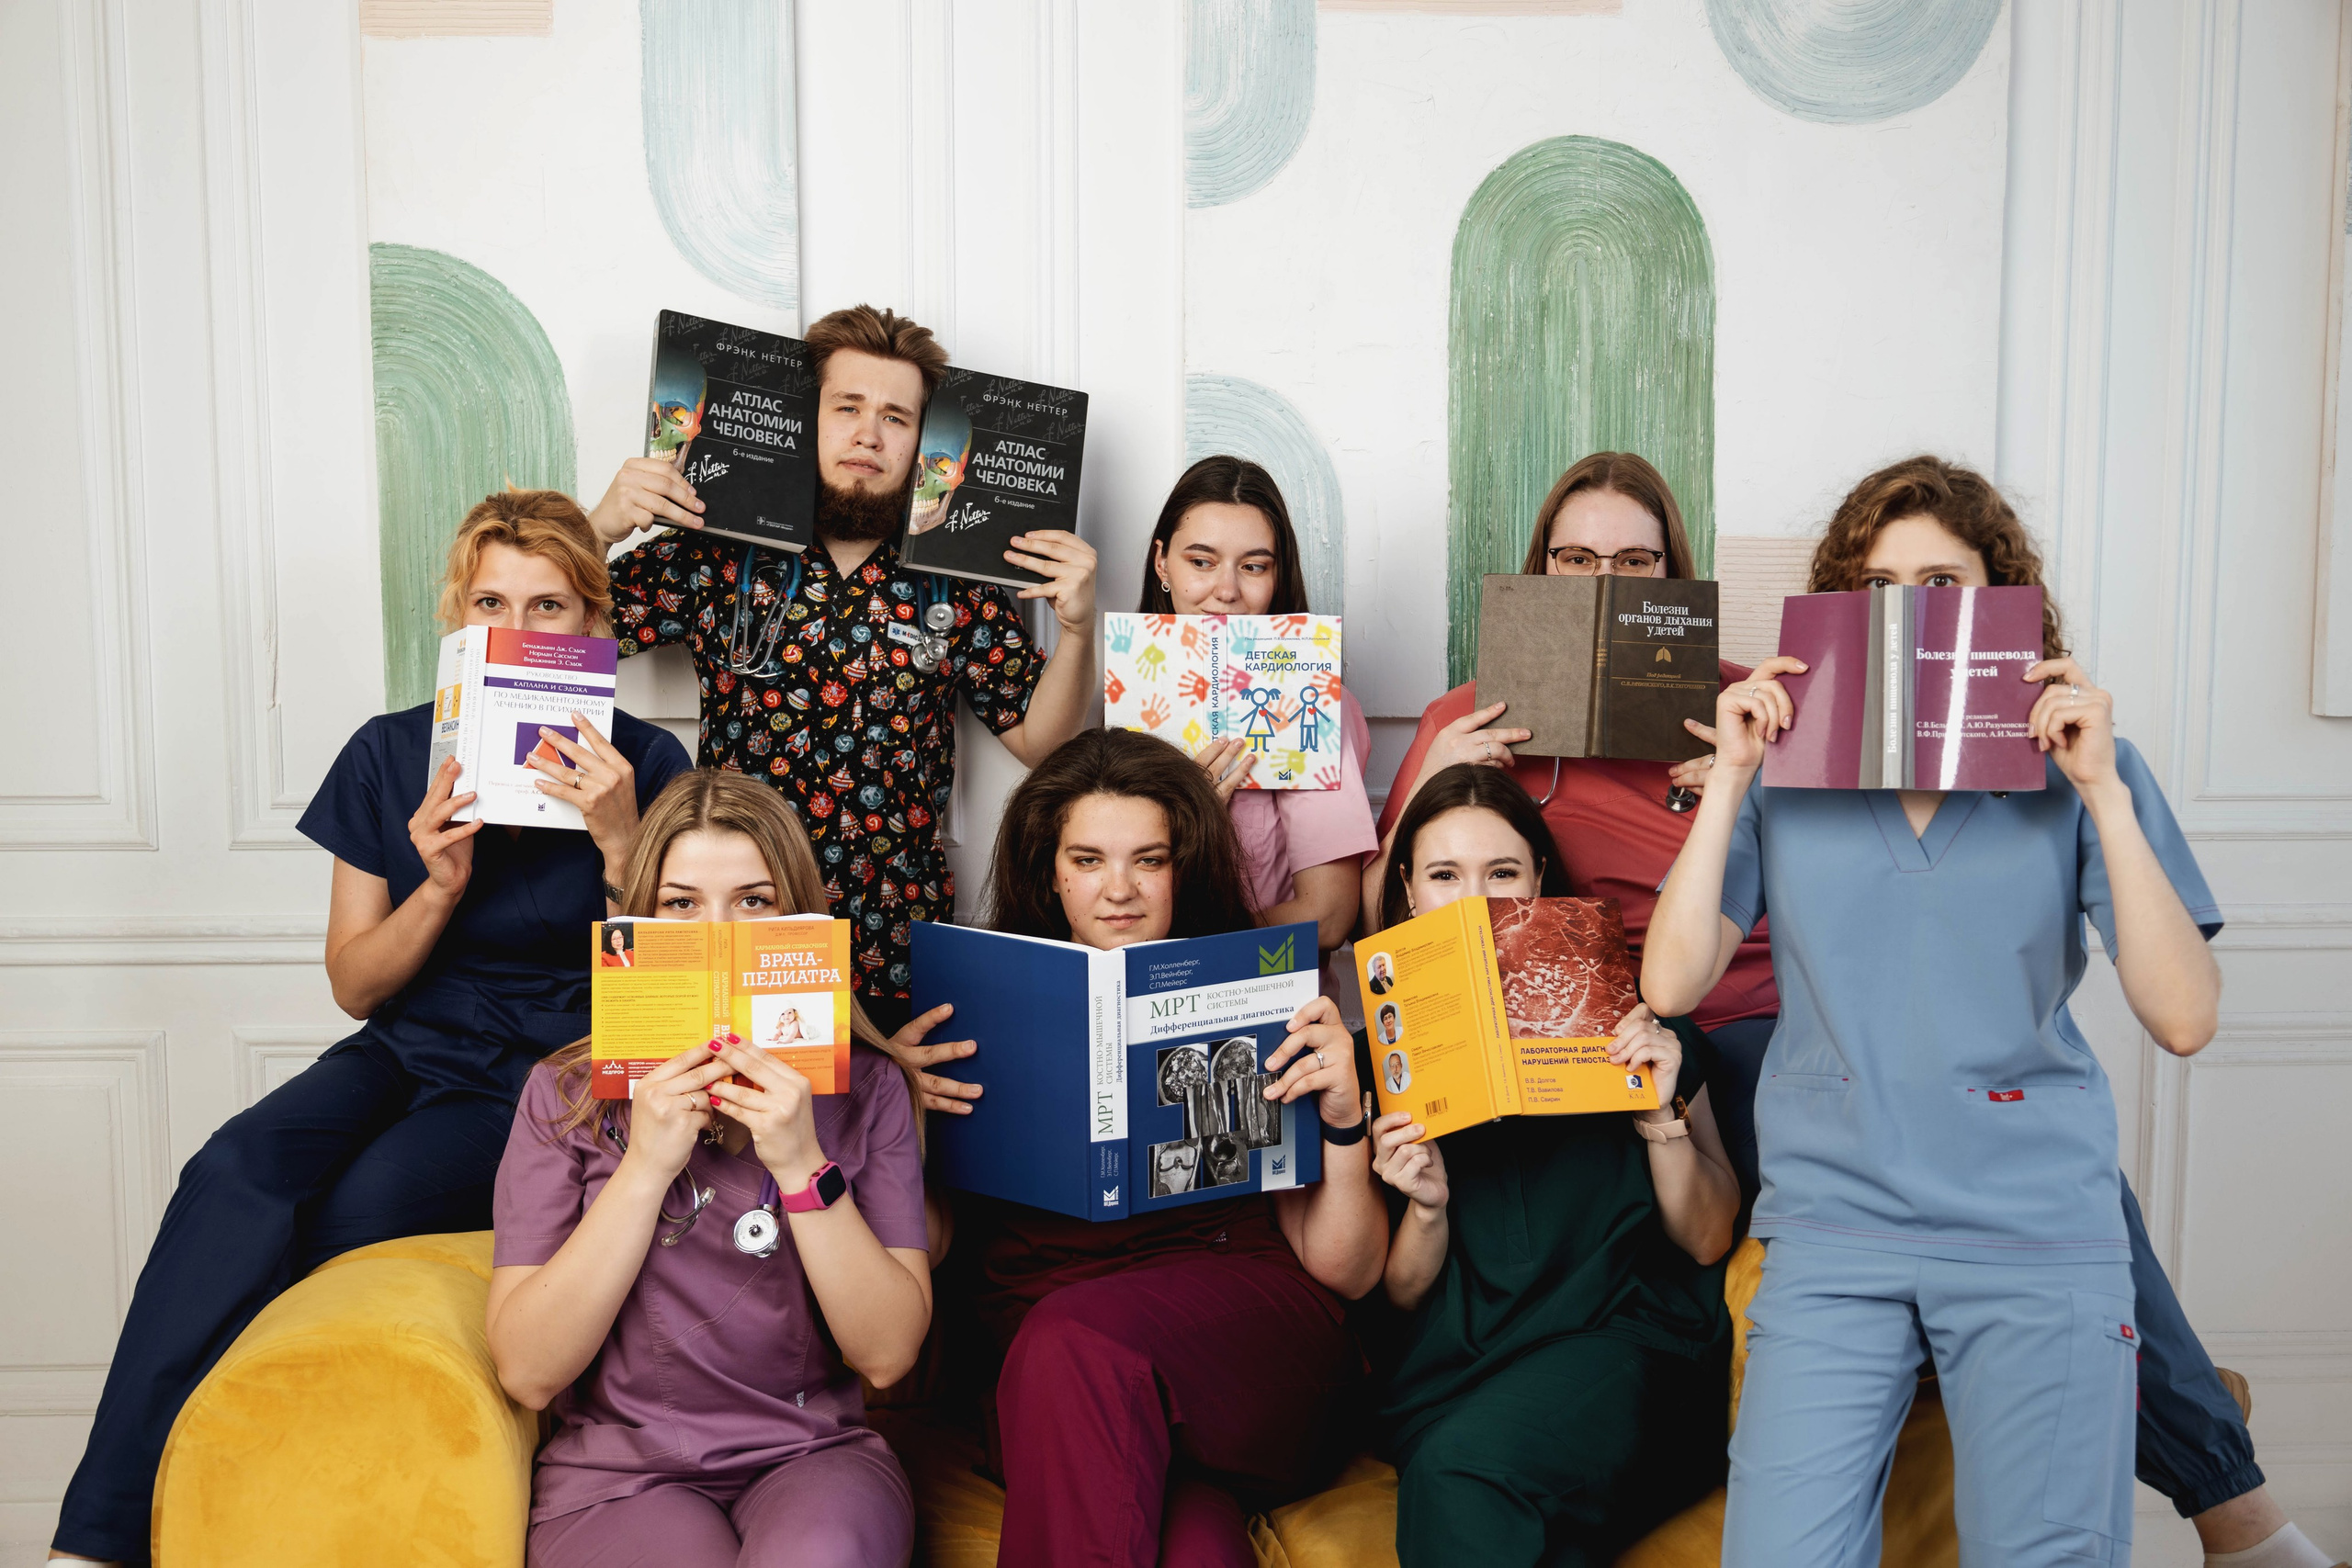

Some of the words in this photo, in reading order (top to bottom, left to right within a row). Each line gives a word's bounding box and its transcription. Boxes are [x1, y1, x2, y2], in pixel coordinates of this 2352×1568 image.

[717, 343, 756, 358] ФРЭНК
[762, 353, 803, 367] НЕТТЕР
[731, 390, 783, 412] АТЛАС
[983, 394, 1022, 408] ФРЭНК
[1027, 402, 1068, 416] НЕТТЕР
[708, 402, 802, 434] АНАТОМИИ
[713, 420, 796, 449] ЧЕЛОВЕКА
[732, 448, 745, 457] 6-е
[746, 453, 775, 464] издание
[995, 440, 1046, 460] АТЛАС
[972, 452, 1065, 480] АНАТОМИИ
[976, 469, 1057, 496] ЧЕЛОВЕКА
[994, 496, 1006, 504] 6-е
[1007, 501, 1035, 510] издание
[1643, 601, 1689, 615] Болезни
[1618, 613, 1662, 626] органов
[1664, 615, 1713, 626] дыхания
[1646, 626, 1654, 637] у
[1654, 626, 1684, 636] детей
[1889, 623, 1898, 652] детей
[528, 649, 552, 658] Норман
[1245, 650, 1297, 660] ДЕТСКАЯ
[1970, 650, 2036, 660] пищевода
[526, 671, 578, 681] РУКОВОДСТВО
[1211, 637, 1220, 708] КАРДИОЛОГИЯ
[1245, 662, 1332, 672] КАРДИОЛОГИЯ
[1964, 666, 1998, 677] етей
[514, 681, 548, 690] КАПЛАНА
[559, 684, 588, 694] СЭДОКА
[1889, 661, 1898, 710] пищевода
[493, 700, 537, 710] ЛЕЧЕНИЮ
[509, 692, 606, 706] МЕДИКАМЕНТОЗНОМУ
[1887, 712, 1897, 753] Болезни
[760, 952, 823, 968] ВРАЧА-
[741, 968, 842, 988] ПЕДИАТРА
[1148, 979, 1187, 989] С.П.Мейерс
[721, 971, 730, 1018] КАРМАННЫЙ
[1149, 994, 1201, 1019] МРТ
[1206, 979, 1295, 1000] КОСТНО-МЫШЕЧНОЙ
[1486, 976, 1496, 1007] ДИАГНОСТИКА
[1206, 998, 1249, 1010] СИСТЕМЫ
[1150, 1013, 1238, 1035] Дифференциальная
[1240, 1006, 1295, 1021] диагностика
[1492, 1007, 1500, 1039] ЛАБОРАТОРНАЯ
[1094, 995, 1103, 1086] КОСТНО-МЫШЕЧНОЙ
[1521, 1046, 1578, 1055] ЛАБОРАТОРНАЯ
[1581, 1045, 1606, 1054] ДИАГН
[1521, 1056, 1569, 1066] НАРУШЕНИЙ
[1097, 1091, 1113, 1134] МРТ
